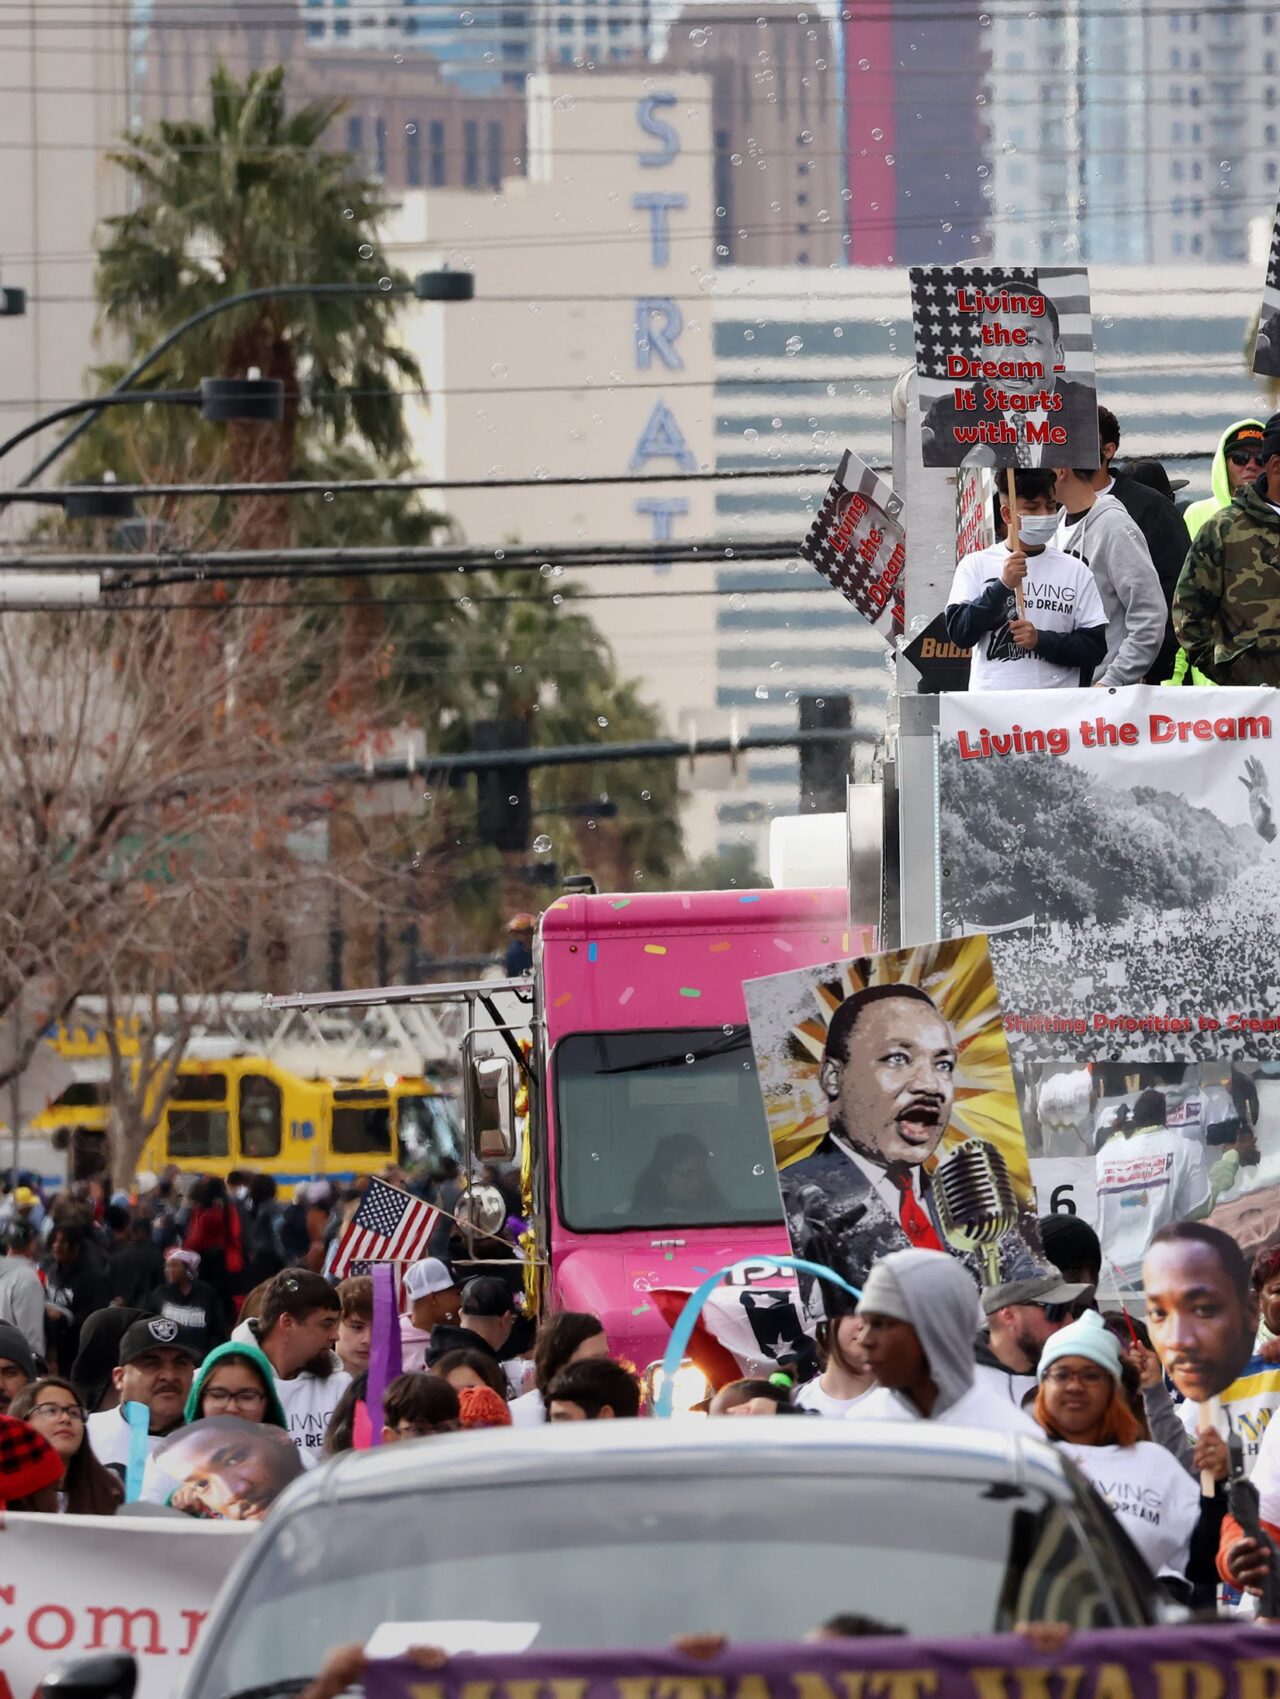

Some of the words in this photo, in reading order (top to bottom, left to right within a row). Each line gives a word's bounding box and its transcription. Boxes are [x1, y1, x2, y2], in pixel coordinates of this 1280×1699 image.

[956, 289, 1046, 317] Living
[628, 90, 698, 575] STRAT
[980, 322, 1029, 347] the
[946, 355, 1044, 379] Dream
[954, 388, 977, 411] It
[983, 387, 1063, 412] Starts
[953, 420, 1018, 444] with
[1025, 421, 1067, 444] Me
[827, 493, 869, 554] Living
[857, 527, 884, 564] the
[867, 543, 905, 607] Dream
[1023, 582, 1076, 602] IVING
[1036, 598, 1073, 615] DREAM
[957, 725, 1070, 760] Living
[1079, 716, 1139, 747] the
[1148, 712, 1272, 744] Dream
[1093, 1013, 1192, 1033] Priorities
[1198, 1015, 1220, 1032] to
